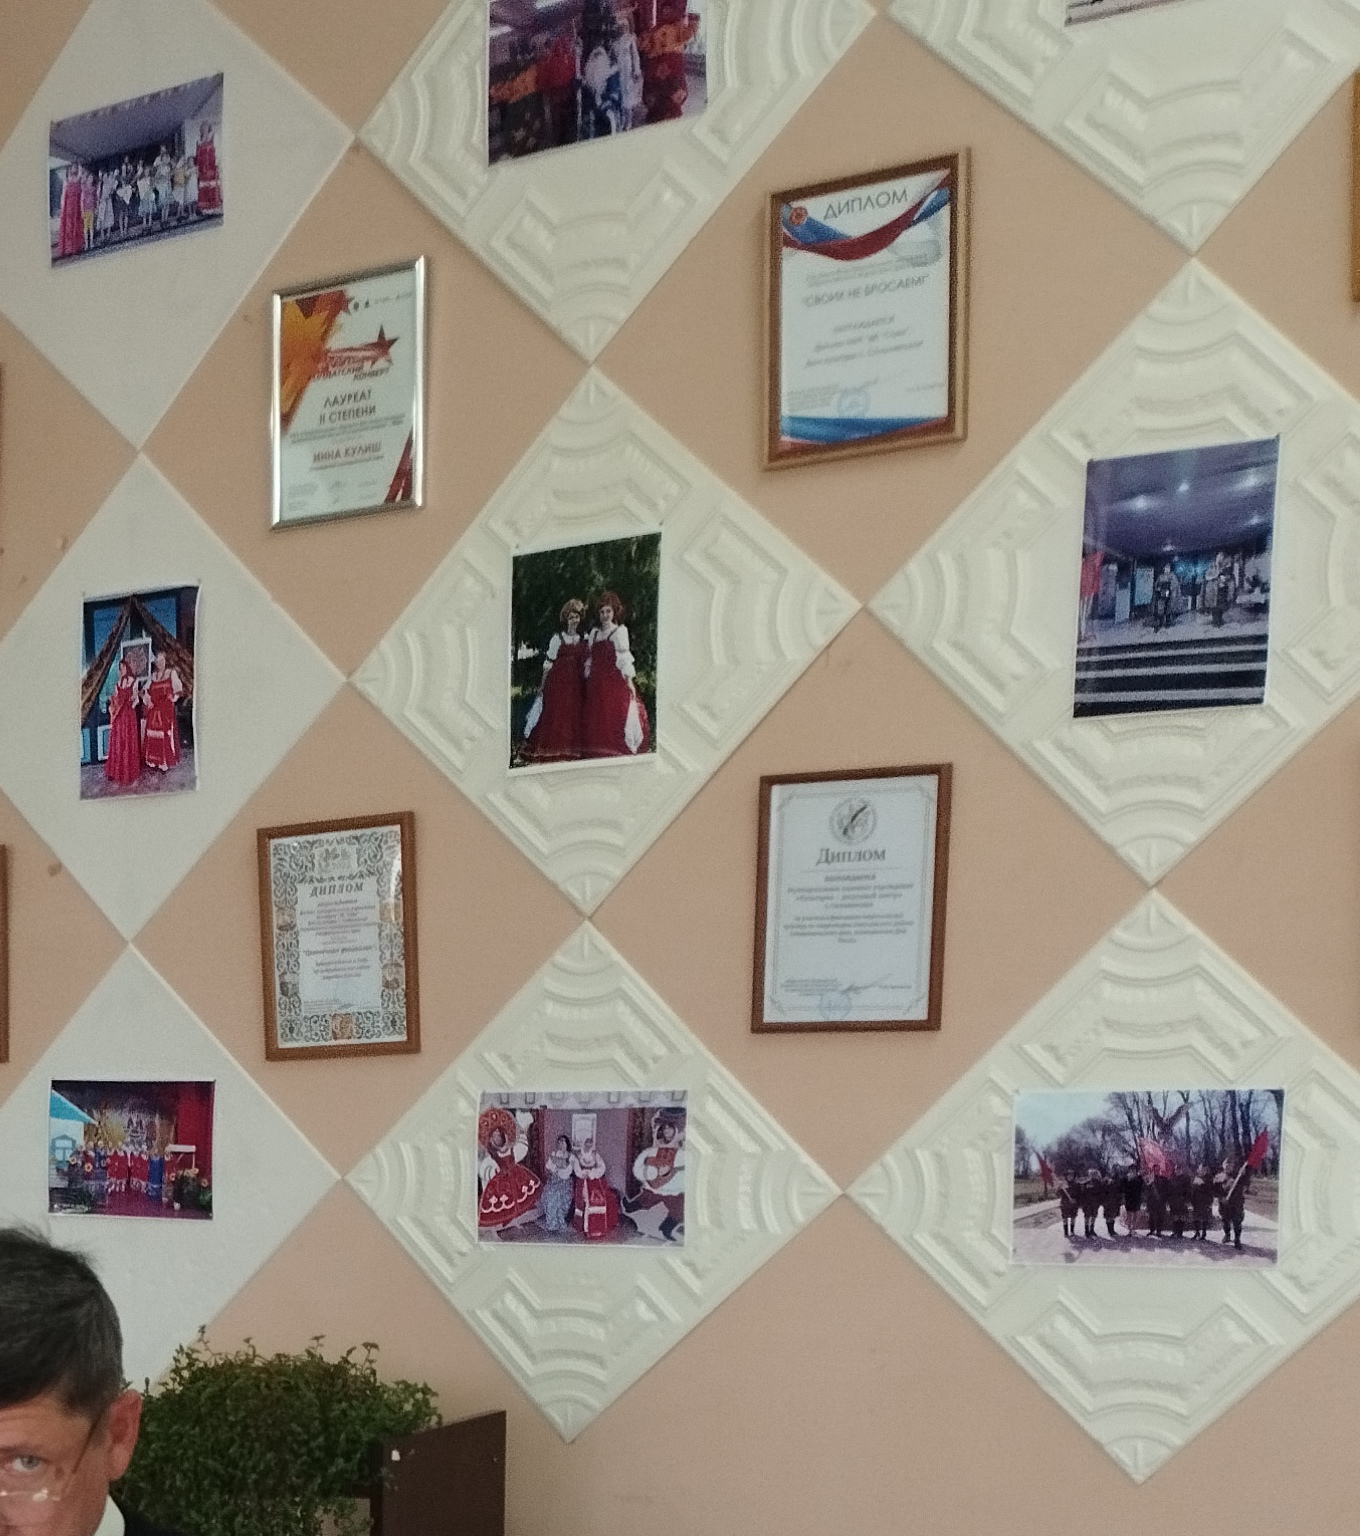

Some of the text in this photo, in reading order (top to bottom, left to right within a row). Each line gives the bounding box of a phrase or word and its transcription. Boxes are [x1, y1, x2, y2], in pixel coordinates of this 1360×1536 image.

[824, 188, 908, 220] ДИПЛОМ
[324, 389, 372, 408] ЛАУРЕАТ
[328, 405, 377, 423] СТЕПЕНИ
[310, 882, 364, 898] ДИПЛОМ
